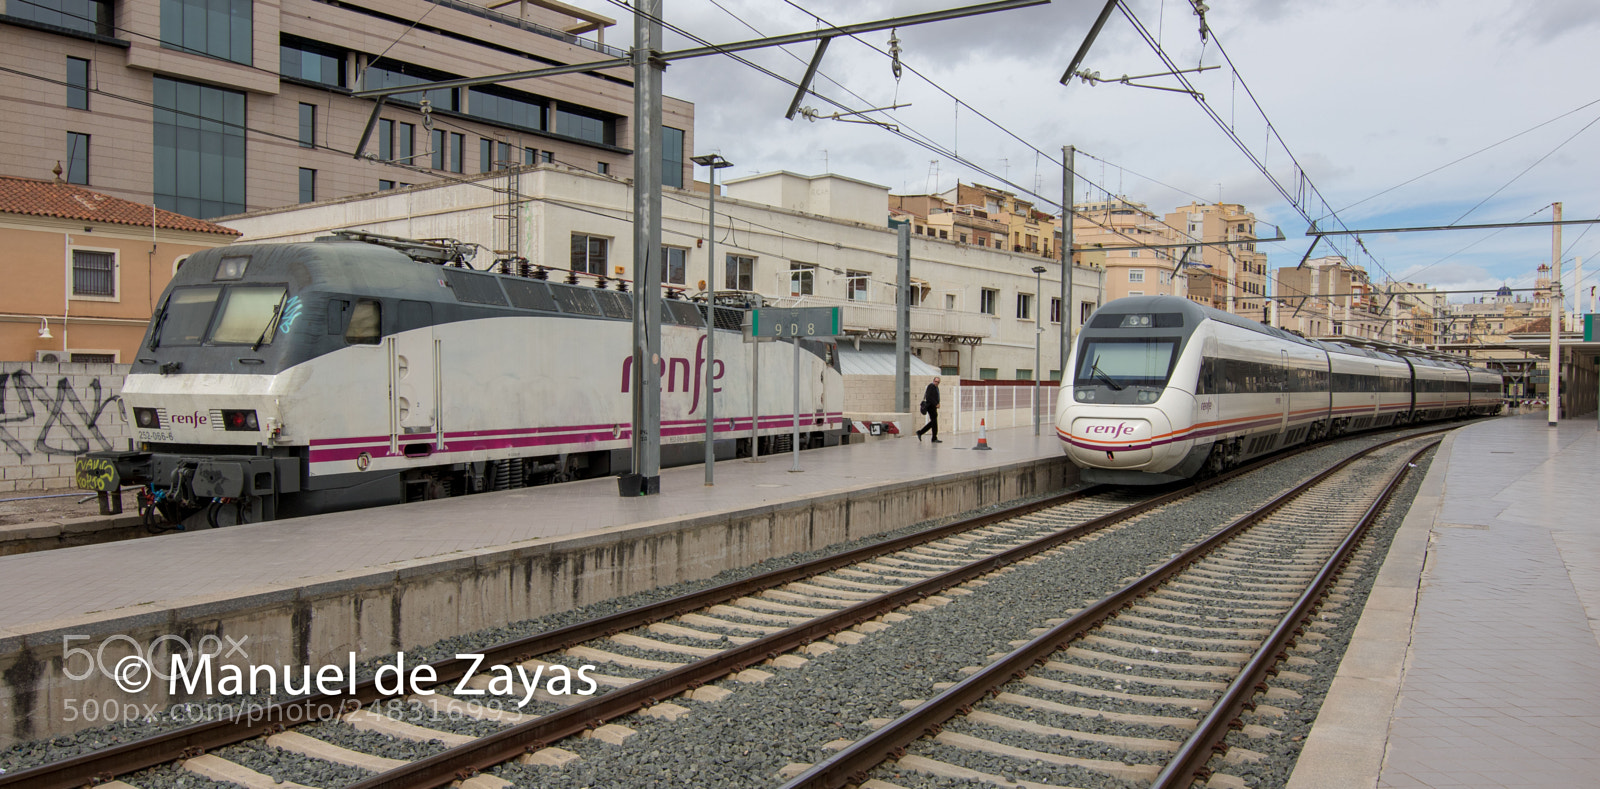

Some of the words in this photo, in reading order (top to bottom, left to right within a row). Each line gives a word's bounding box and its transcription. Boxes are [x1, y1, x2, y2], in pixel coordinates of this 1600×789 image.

[775, 323, 782, 336] 9
[791, 323, 798, 336] D
[807, 322, 815, 336] 8
[1200, 397, 1212, 413] renfe
[171, 411, 207, 428] renfe
[138, 430, 174, 441] 252-066-6
[1085, 421, 1135, 439] renfe
